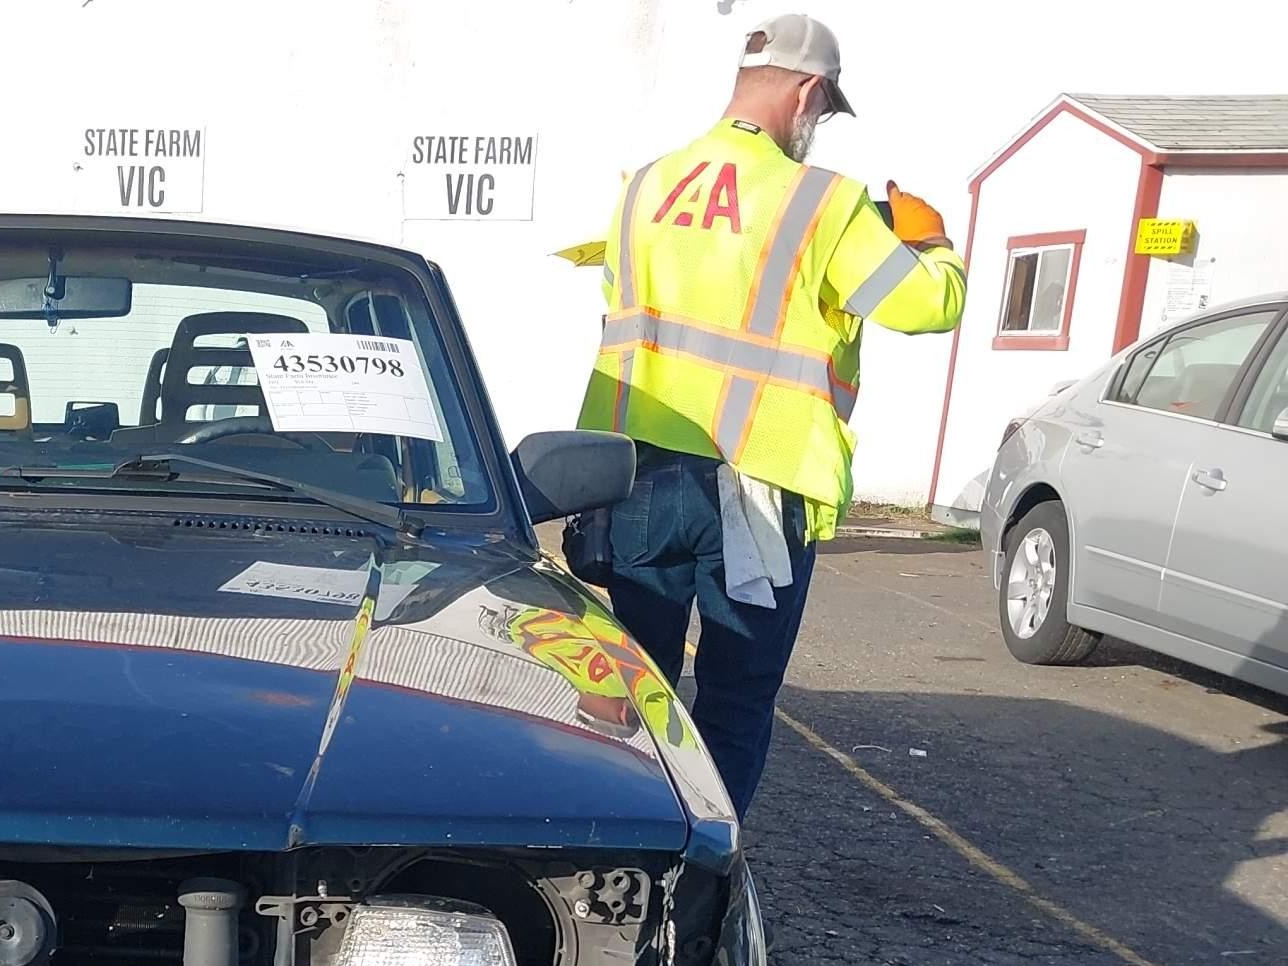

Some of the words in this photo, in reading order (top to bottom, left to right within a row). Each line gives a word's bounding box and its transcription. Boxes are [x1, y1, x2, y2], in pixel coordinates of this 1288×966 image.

[84, 128, 139, 157] STATE
[144, 129, 201, 158] FARM
[412, 136, 469, 164] STATE
[474, 136, 532, 165] FARM
[117, 165, 165, 208] VIC
[445, 173, 495, 216] VIC
[273, 355, 405, 378] 43530798
